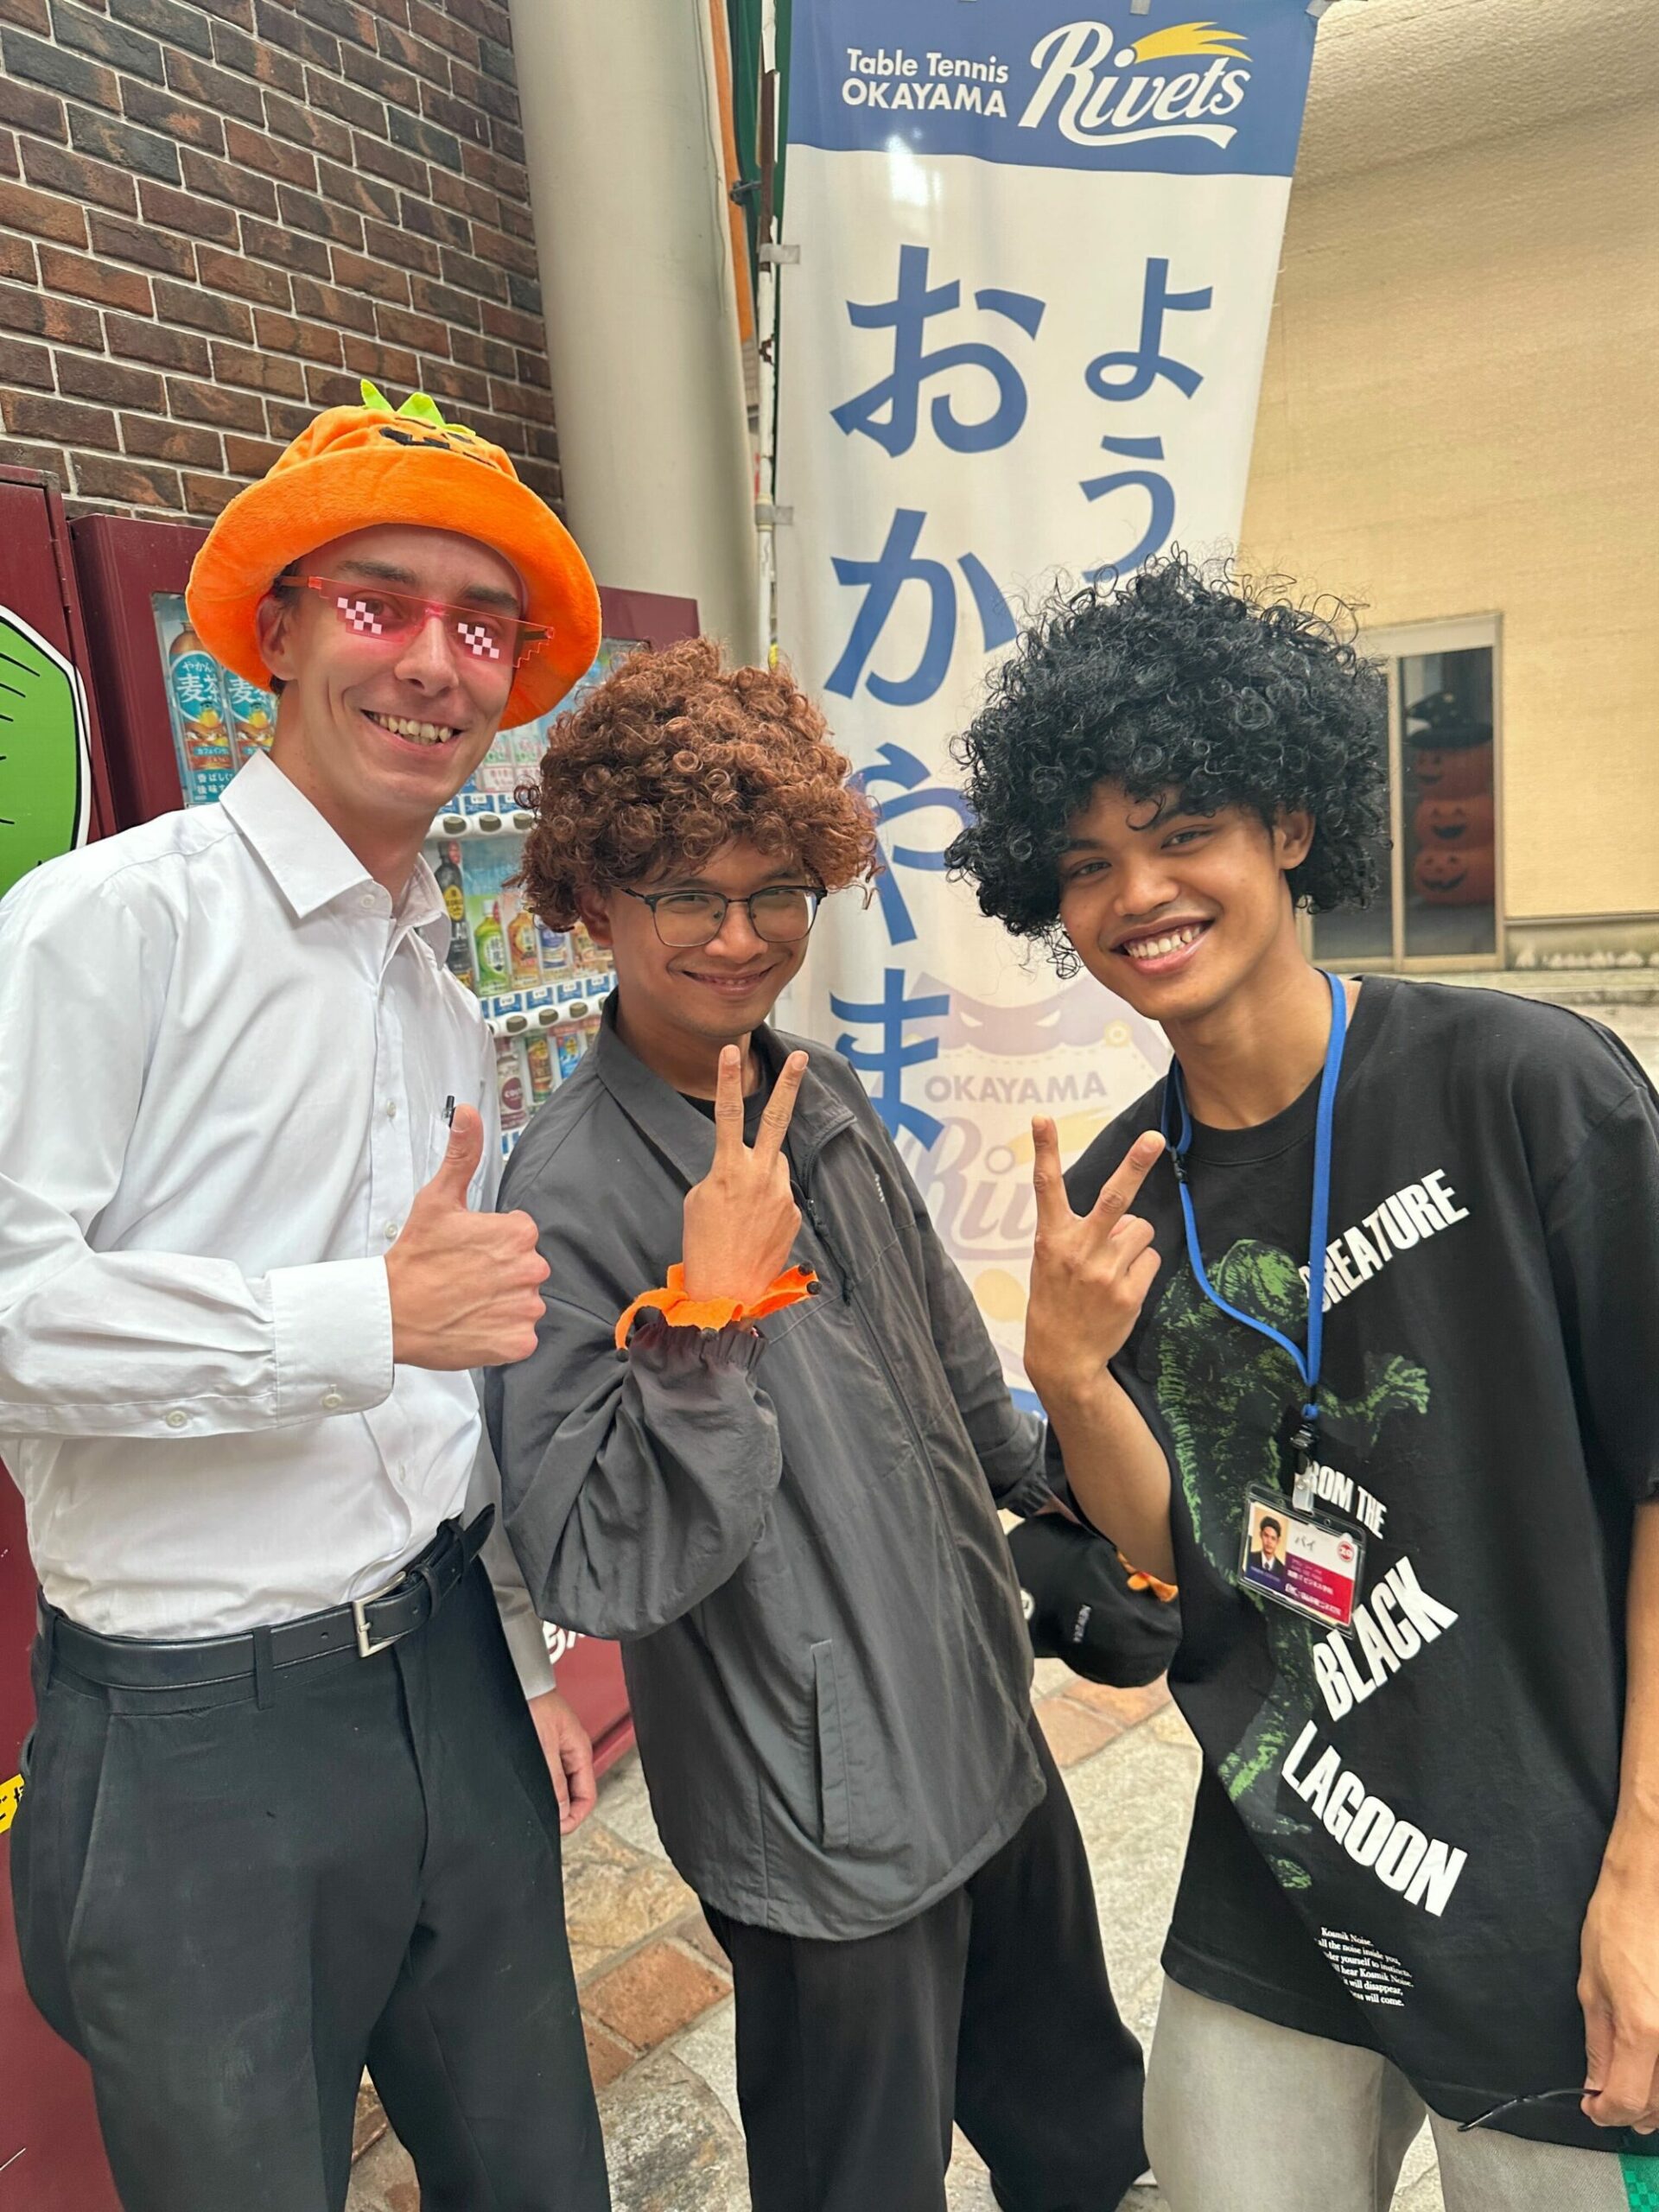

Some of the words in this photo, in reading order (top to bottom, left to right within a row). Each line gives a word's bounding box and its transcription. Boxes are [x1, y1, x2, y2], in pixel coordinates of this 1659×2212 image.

[847, 48, 918, 76] Table
[926, 51, 1009, 84] Tennis
[841, 79, 1008, 118] OKAYAMA
[1018, 21, 1252, 149] Rivets
[176, 672, 219, 704] 麦茶
[823, 244, 1046, 1152] おかやま
[924, 1070, 1107, 1104] OKAYAMA
[1306, 1460, 1355, 1511] ROM
[1356, 1484, 1387, 1540] THE
[1313, 1556, 1459, 1721] BLACK
[1281, 1719, 1468, 1916] LAGOON
[1320, 1926, 1350, 1942] Kosmik
[1329, 1940, 1341, 1950] the
[1342, 1944, 1362, 1955] noise
[1362, 1947, 1384, 1960] inside
[1340, 1955, 1370, 1967] yourself
[1371, 1960, 1380, 1968] to
[1341, 1964, 1358, 1976] hear
[1359, 1968, 1390, 1981] Kosmik
[1349, 1979, 1363, 1989] will
[1363, 1980, 1403, 1996] disappear,
[1364, 1993, 1380, 2003] will
[1380, 1997, 1405, 2006] come.
